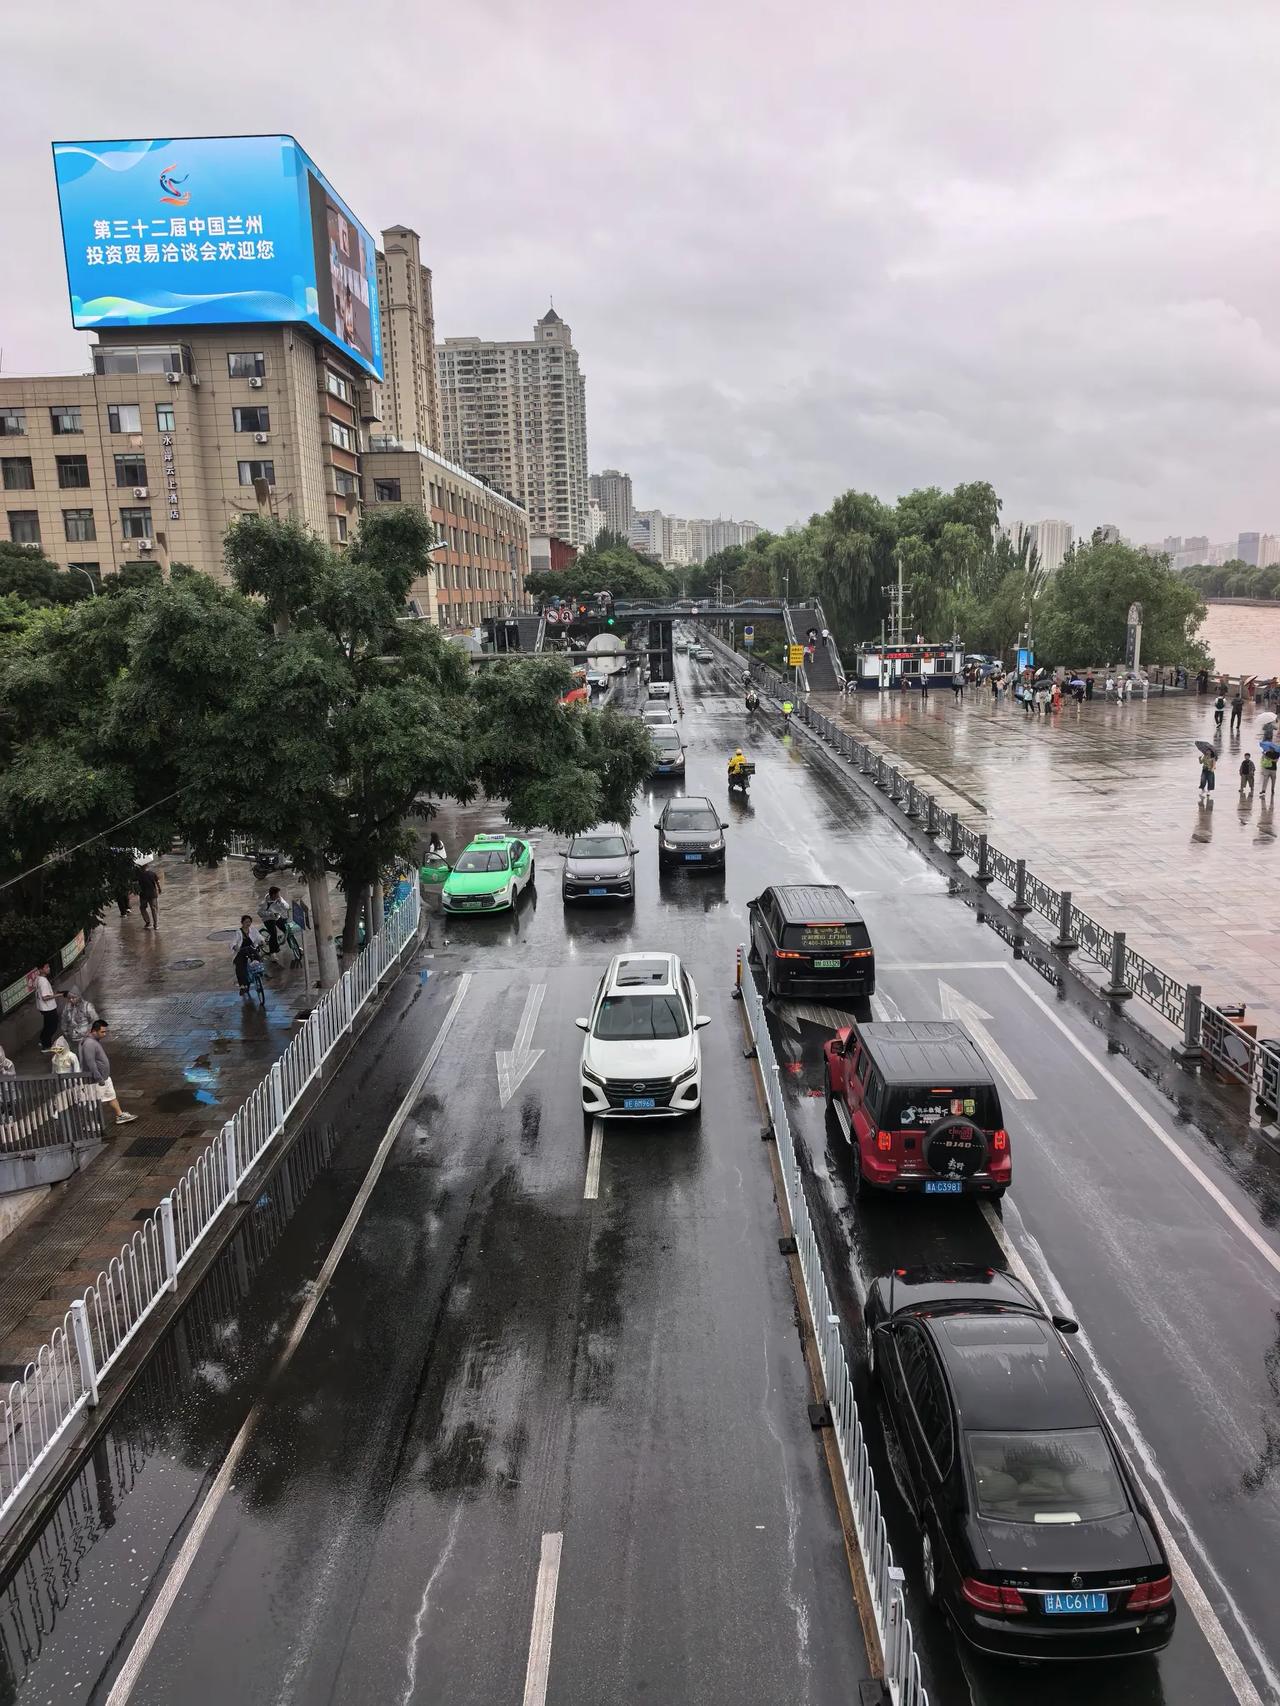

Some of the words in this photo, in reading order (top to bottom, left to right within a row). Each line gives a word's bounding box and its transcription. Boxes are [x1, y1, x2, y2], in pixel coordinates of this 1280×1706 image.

[93, 215, 264, 240] 第三十二届中国兰州
[86, 239, 275, 266] 投资贸易洽谈会欢迎您
[162, 435, 180, 520] 水岸云上酒店
